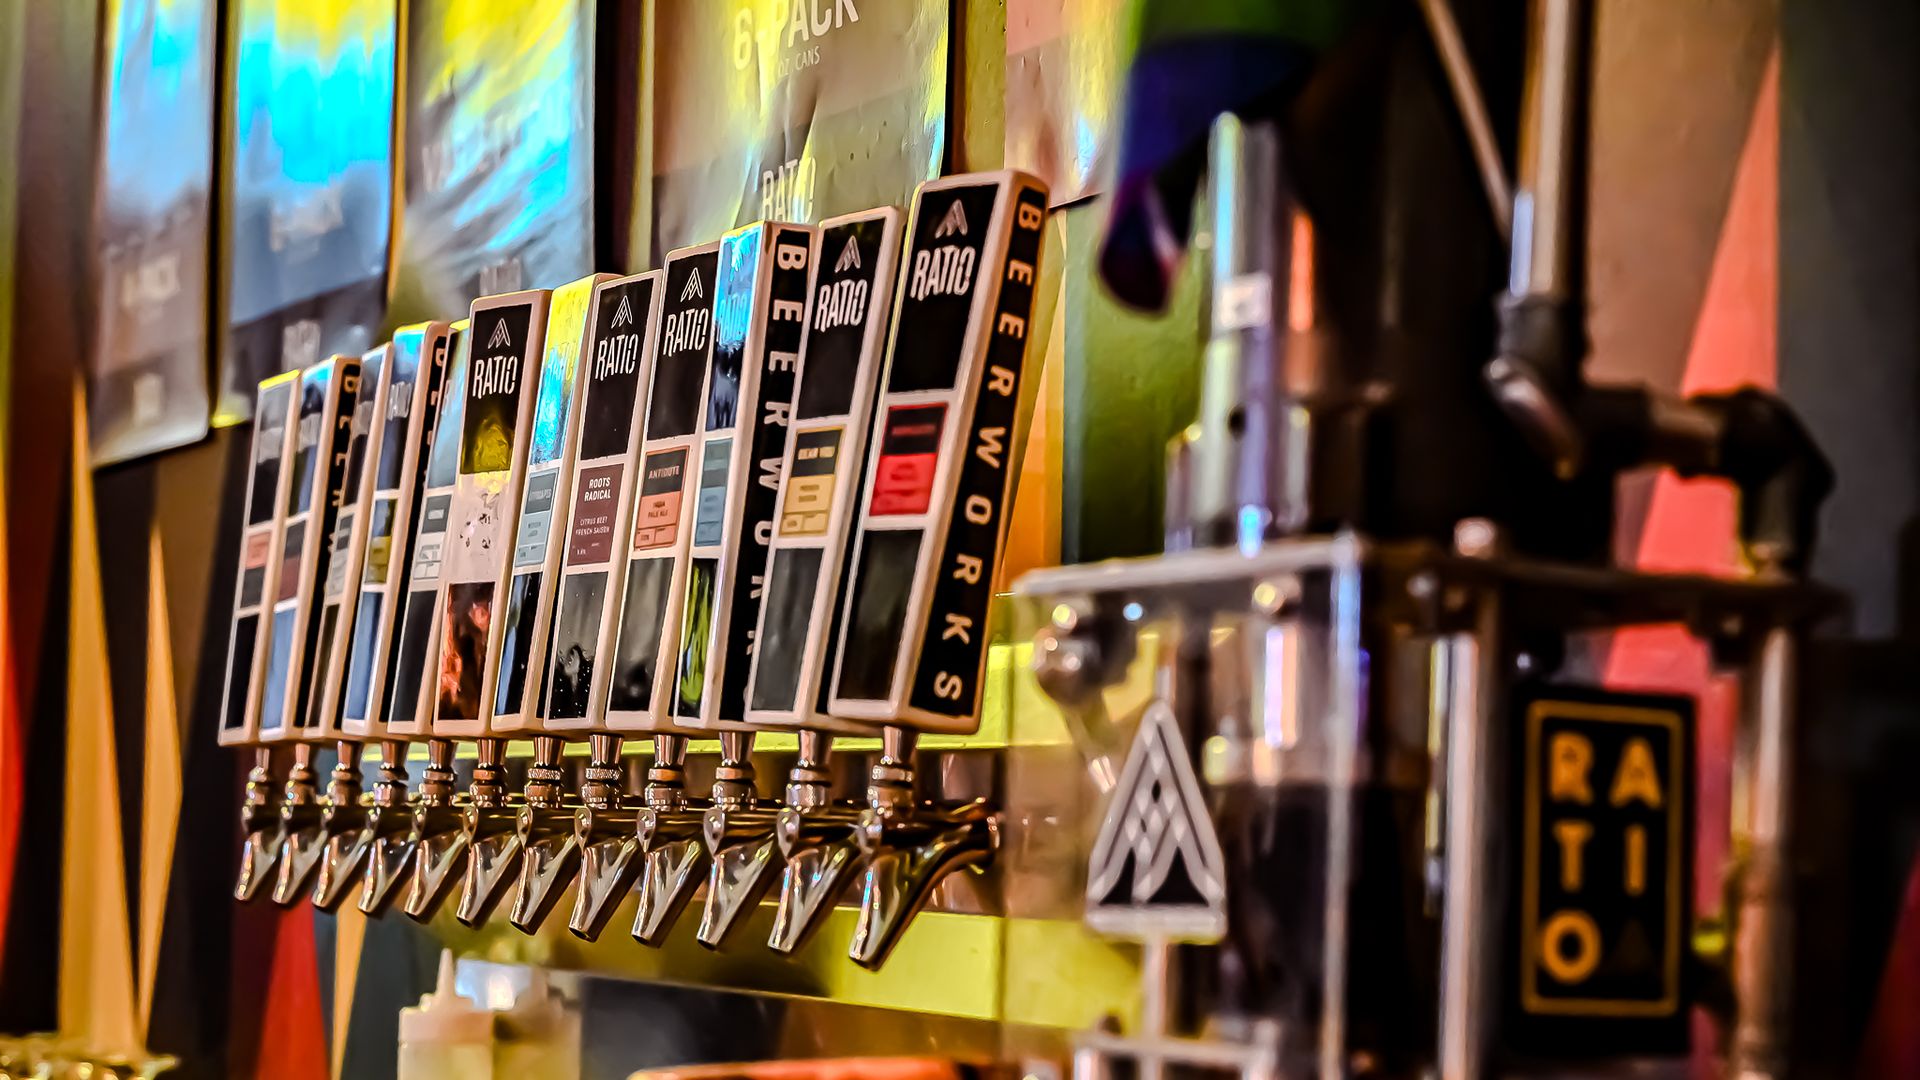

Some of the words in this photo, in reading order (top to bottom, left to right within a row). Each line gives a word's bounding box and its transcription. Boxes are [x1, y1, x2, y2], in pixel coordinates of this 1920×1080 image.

[795, 46, 821, 71] CANS
[910, 244, 976, 301] RATIO
[814, 279, 868, 333] RATIO
[663, 308, 709, 357] RATIO
[472, 355, 518, 399] RATIO
[595, 333, 639, 382] RATIO
[743, 243, 807, 690] BEERWO
[933, 202, 1042, 701] BEERWORKS
[584, 489, 611, 502] RADICAL
[588, 476, 611, 489] ROOTS
